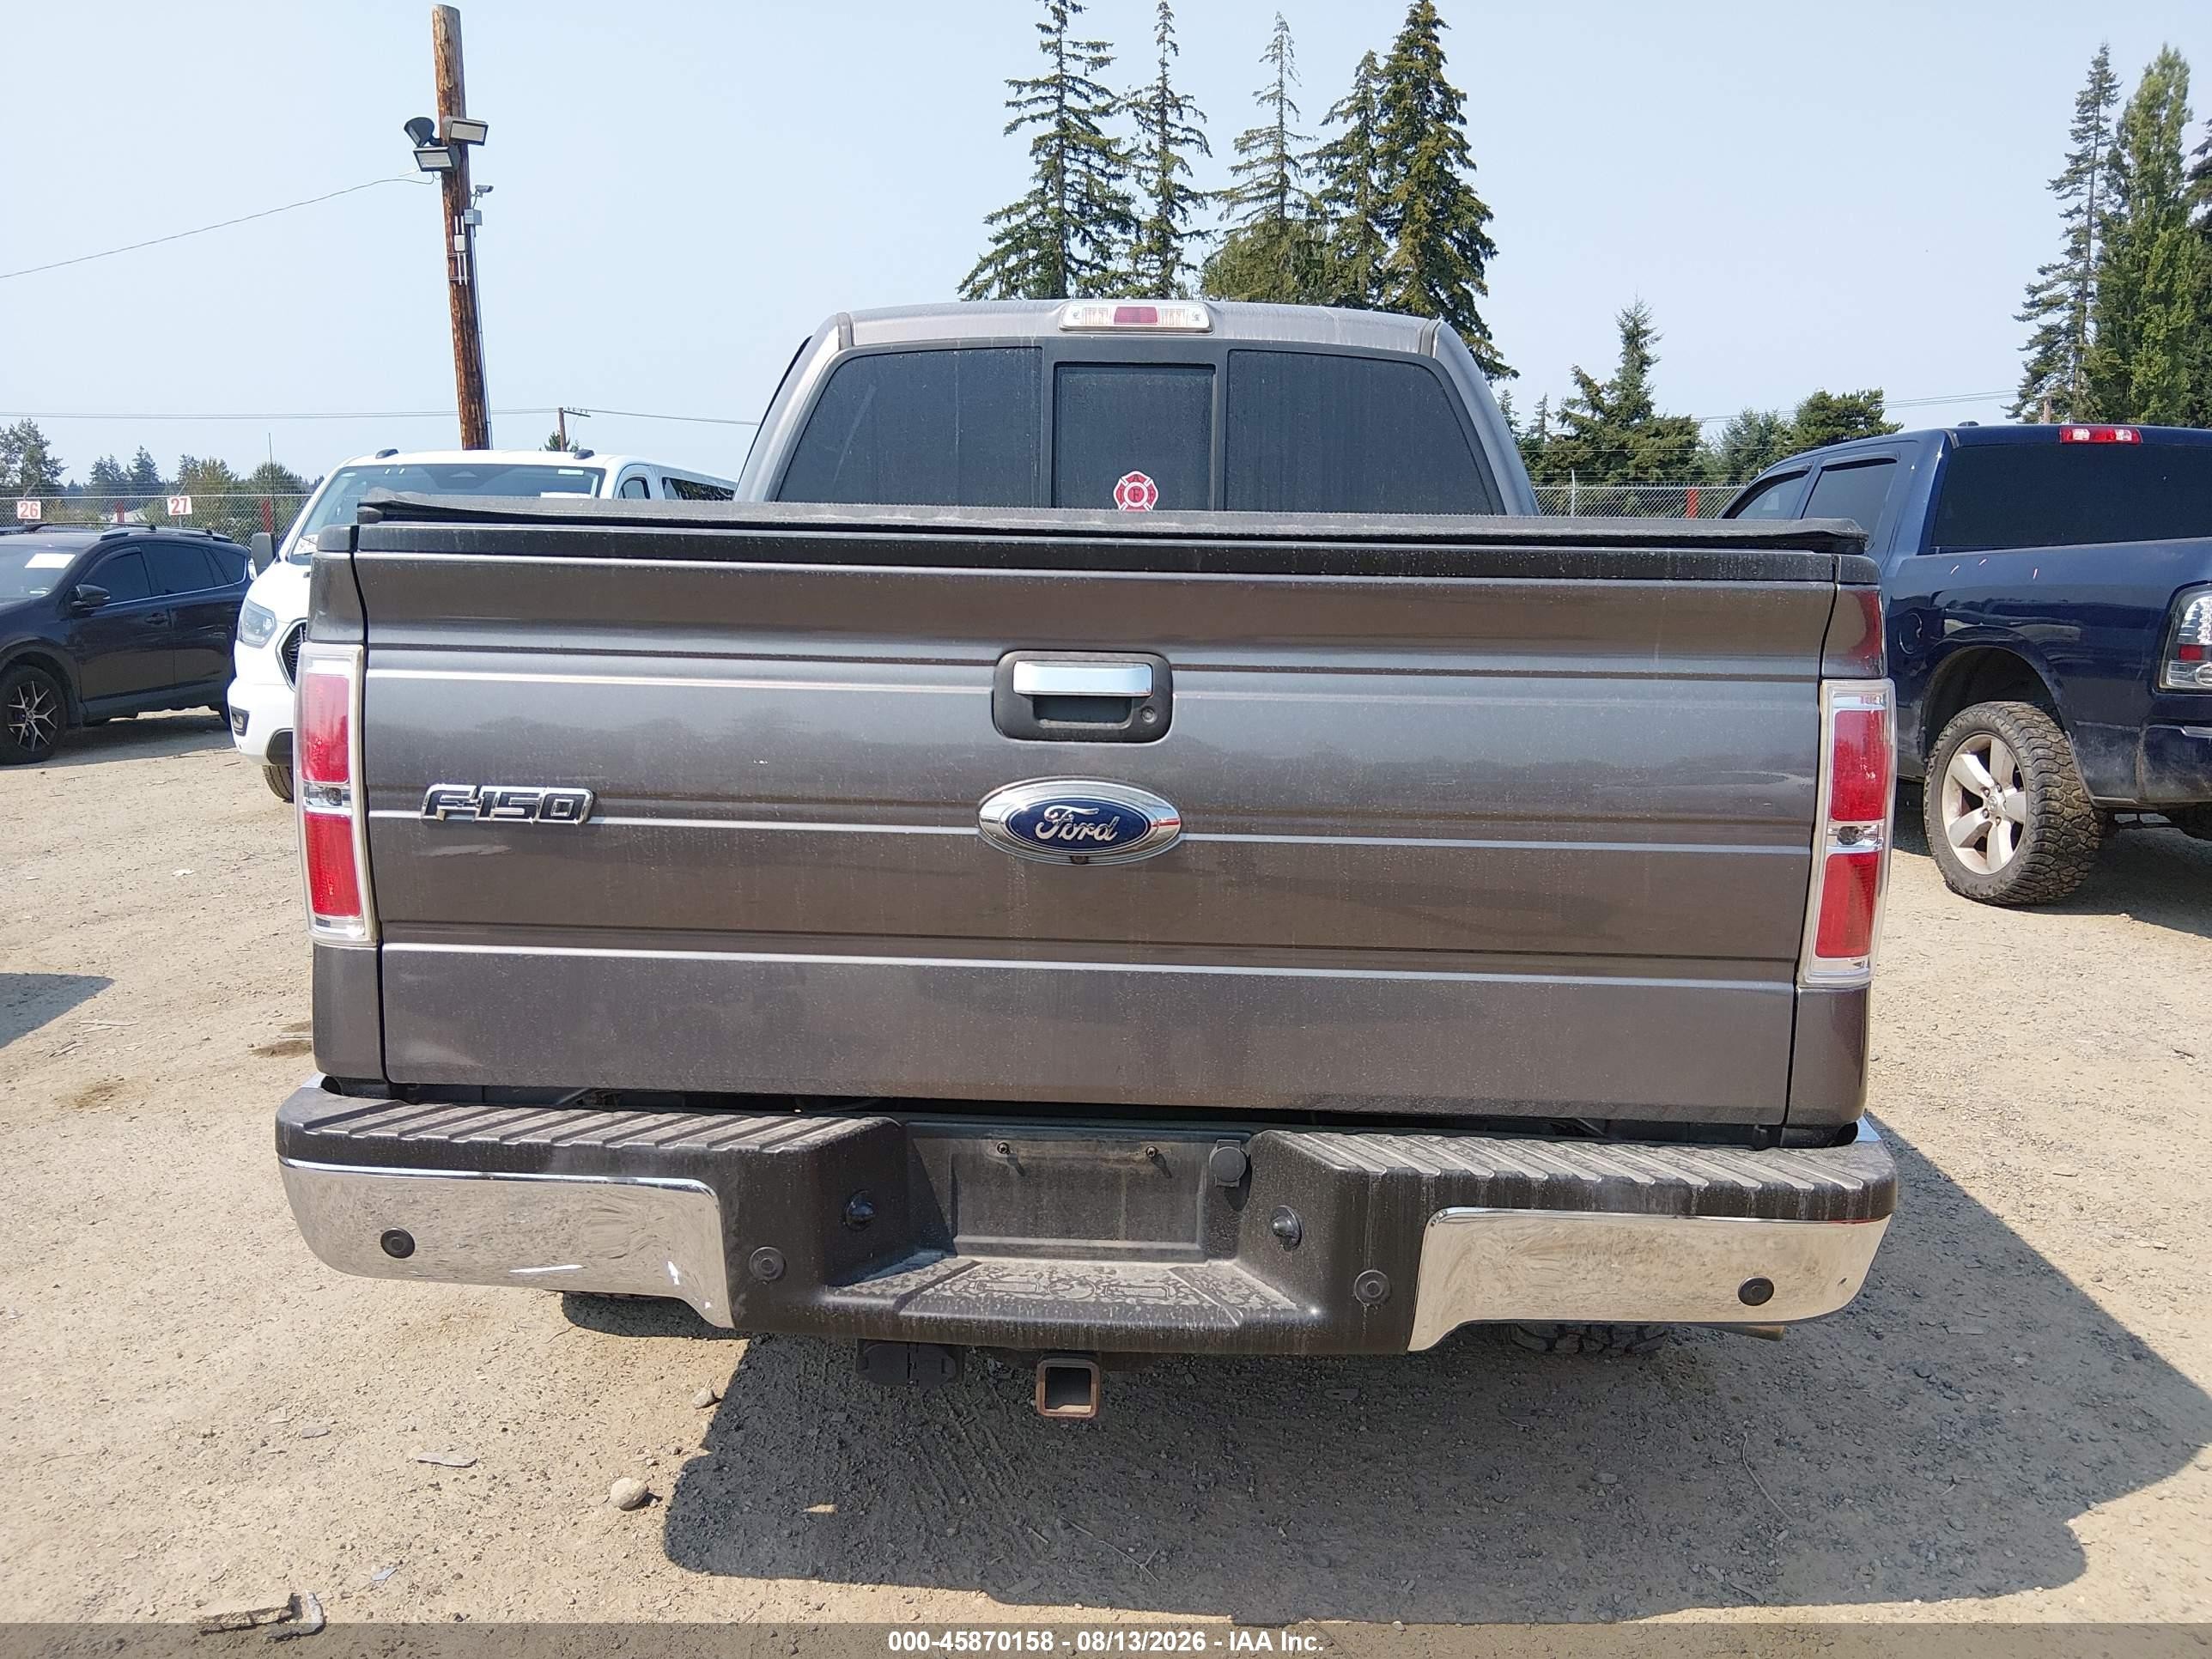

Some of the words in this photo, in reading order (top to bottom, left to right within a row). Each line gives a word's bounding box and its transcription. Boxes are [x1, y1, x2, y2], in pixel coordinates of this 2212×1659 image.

[20, 501, 39, 518] 26
[171, 497, 188, 514] 27
[1035, 805, 1121, 842] Ford
